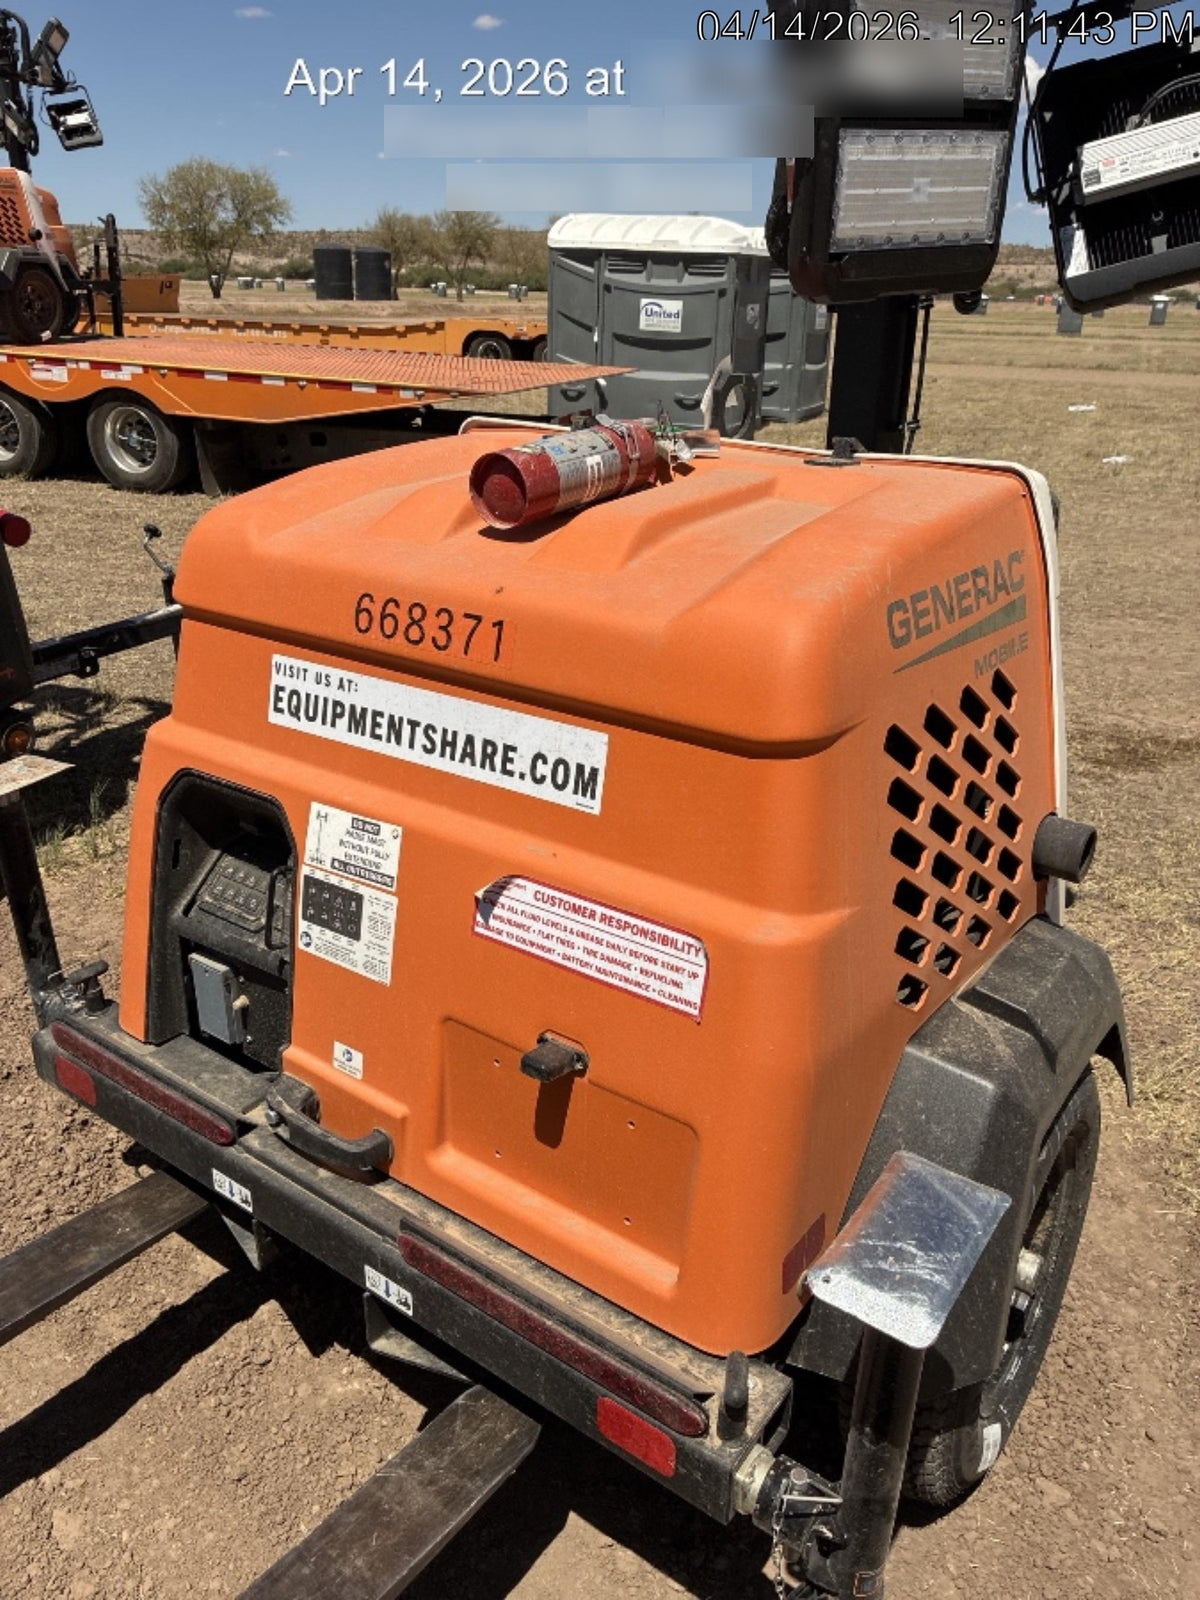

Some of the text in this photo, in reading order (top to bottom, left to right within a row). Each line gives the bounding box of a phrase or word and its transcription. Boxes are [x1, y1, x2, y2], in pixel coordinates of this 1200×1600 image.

[645, 307, 680, 319] United
[355, 593, 504, 662] 668371
[887, 550, 1025, 650] GENERAC
[275, 661, 358, 694] VISIT US AT:
[973, 631, 1029, 680] MOBILE
[273, 684, 600, 801] EQUIPMENTSHARE.COM
[534, 890, 702, 958] CUSTOMER RESPONSIBILITY
